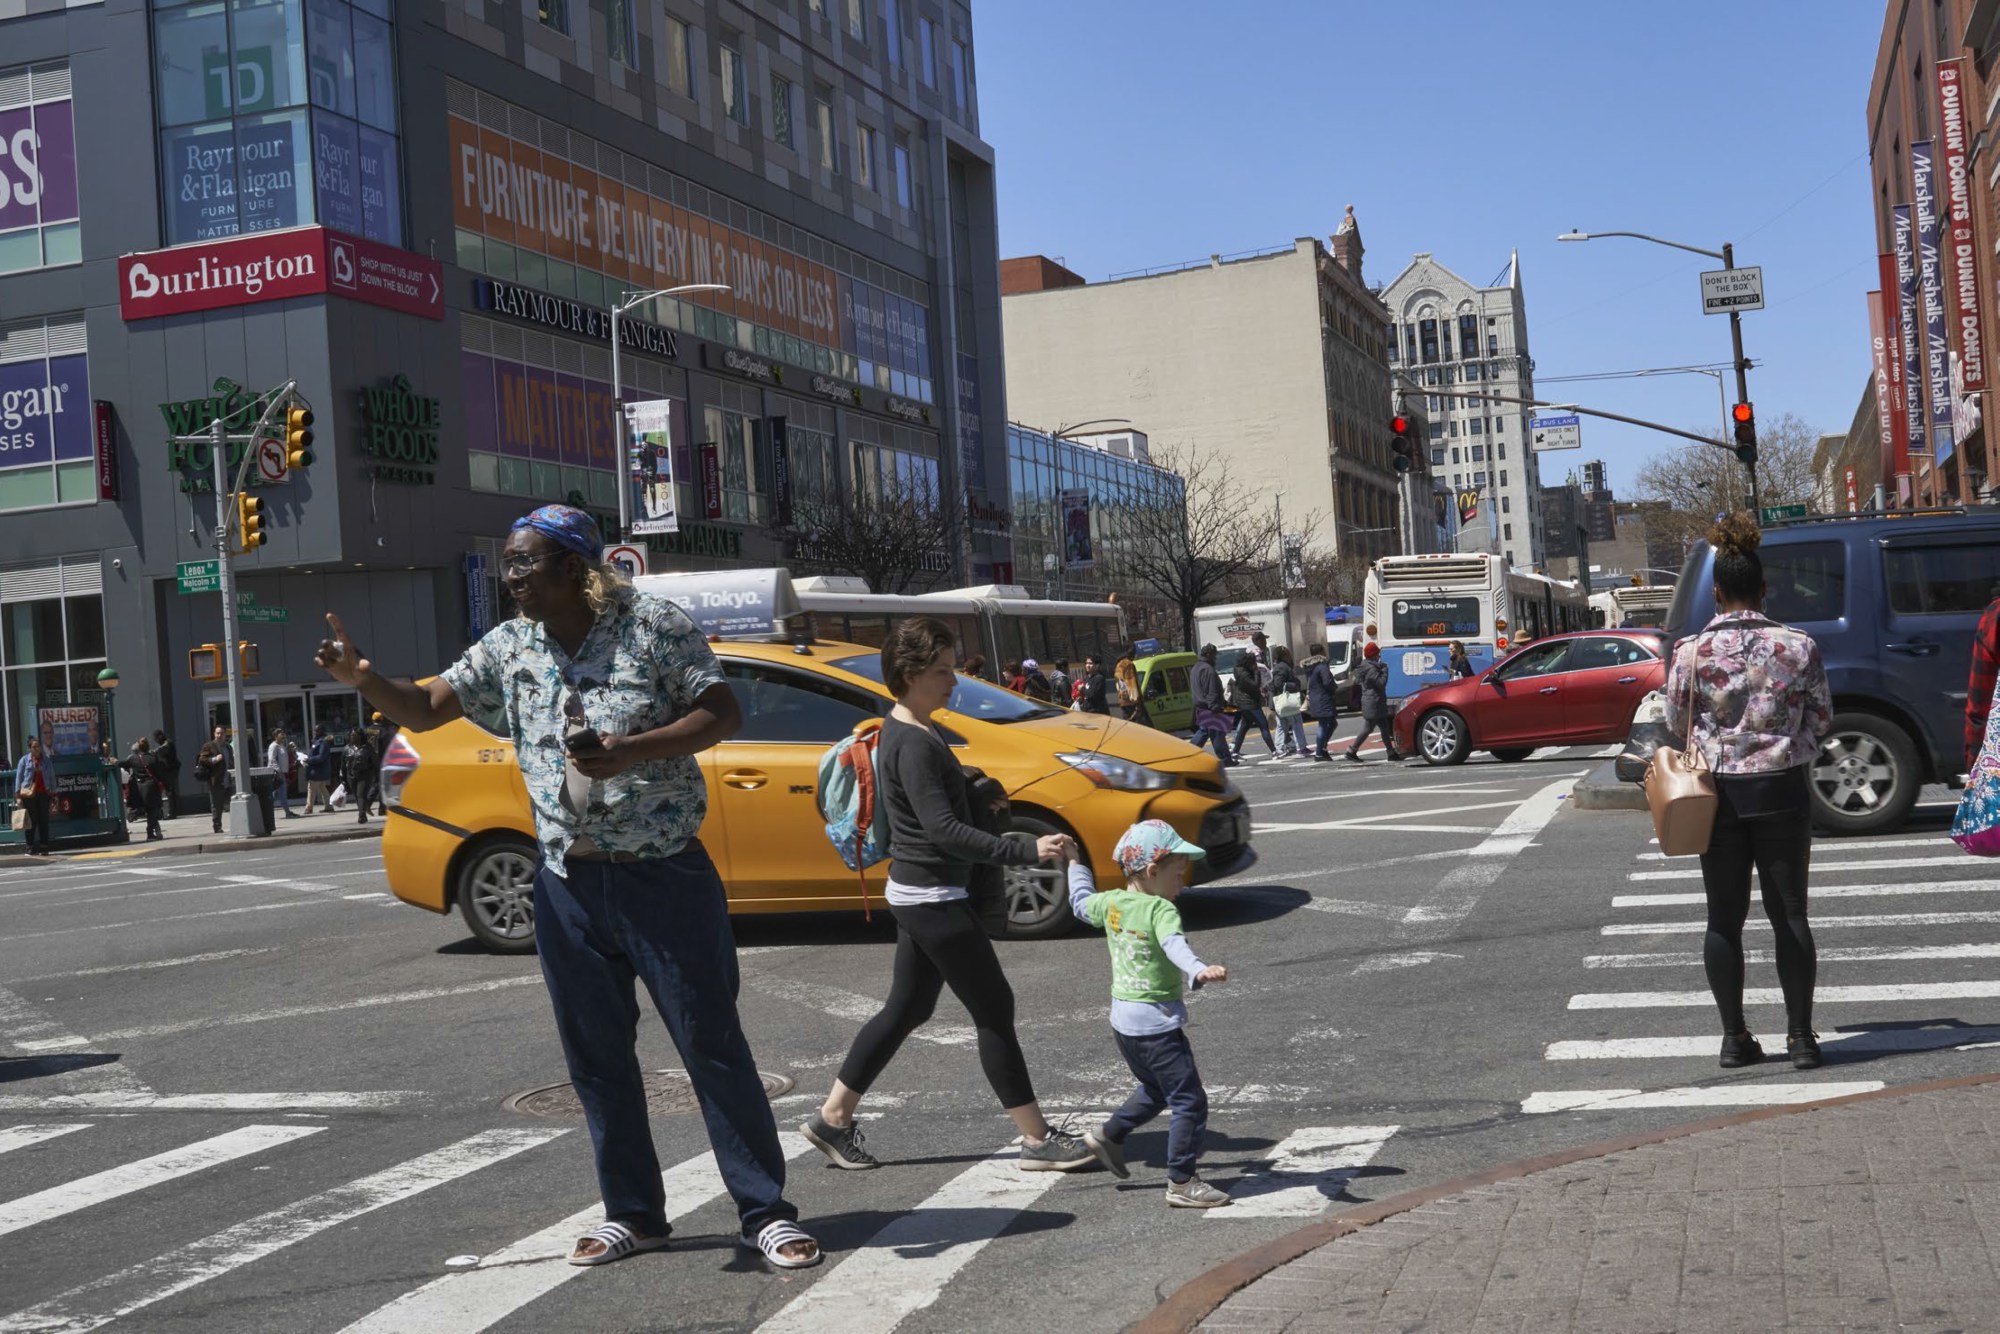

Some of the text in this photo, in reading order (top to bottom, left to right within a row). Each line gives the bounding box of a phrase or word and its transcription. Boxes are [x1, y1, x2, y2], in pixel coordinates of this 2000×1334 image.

[210, 62, 264, 108] TD
[1942, 85, 1970, 221] DUNKIN' DONUTS
[201, 199, 275, 217] FURNURE
[1913, 151, 1936, 233] Marshalls
[197, 218, 281, 239] MATTRSSES
[461, 143, 834, 332] FURNITURE DELIVERY IN 3 DAYS OR LESS
[1895, 213, 1914, 284] Marshalls
[129, 253, 316, 299] Burlington
[360, 257, 423, 282] SHOP WITH US JUST
[361, 273, 419, 297] DOWN THE BLOCK
[1705, 273, 1757, 285] DON'T BLOCK
[1715, 283, 1749, 293] THE BOX
[1920, 242, 1943, 324] Marshalls
[1956, 244, 1978, 312] DUNKIN'
[493, 282, 678, 357] RAYMOUR & FANIGAN
[1736, 294, 1758, 304] POINTS
[1901, 290, 1919, 362] Marshalls
[1962, 315, 1982, 383] DONUTS
[1873, 337, 1892, 444] STAPLES
[1928, 333, 1951, 415] Marshalls
[363, 382, 441, 428] WHOLE
[1557, 417, 1576, 425] LANE
[1907, 369, 1925, 441] Marshalls
[101, 419, 110, 486] Burlington
[370, 423, 440, 465] FOODS
[708, 456, 718, 509] Burlington
[633, 523, 676, 533] Burlington
[183, 564, 206, 577] Lenox
[183, 578, 210, 588] Malcolm
[700, 590, 762, 609] Tokyo.
[1220, 623, 1263, 633] EASTERN
[42, 708, 98, 723] INJURED?
[58, 776, 76, 786] Street
[788, 785, 815, 794] NYC
